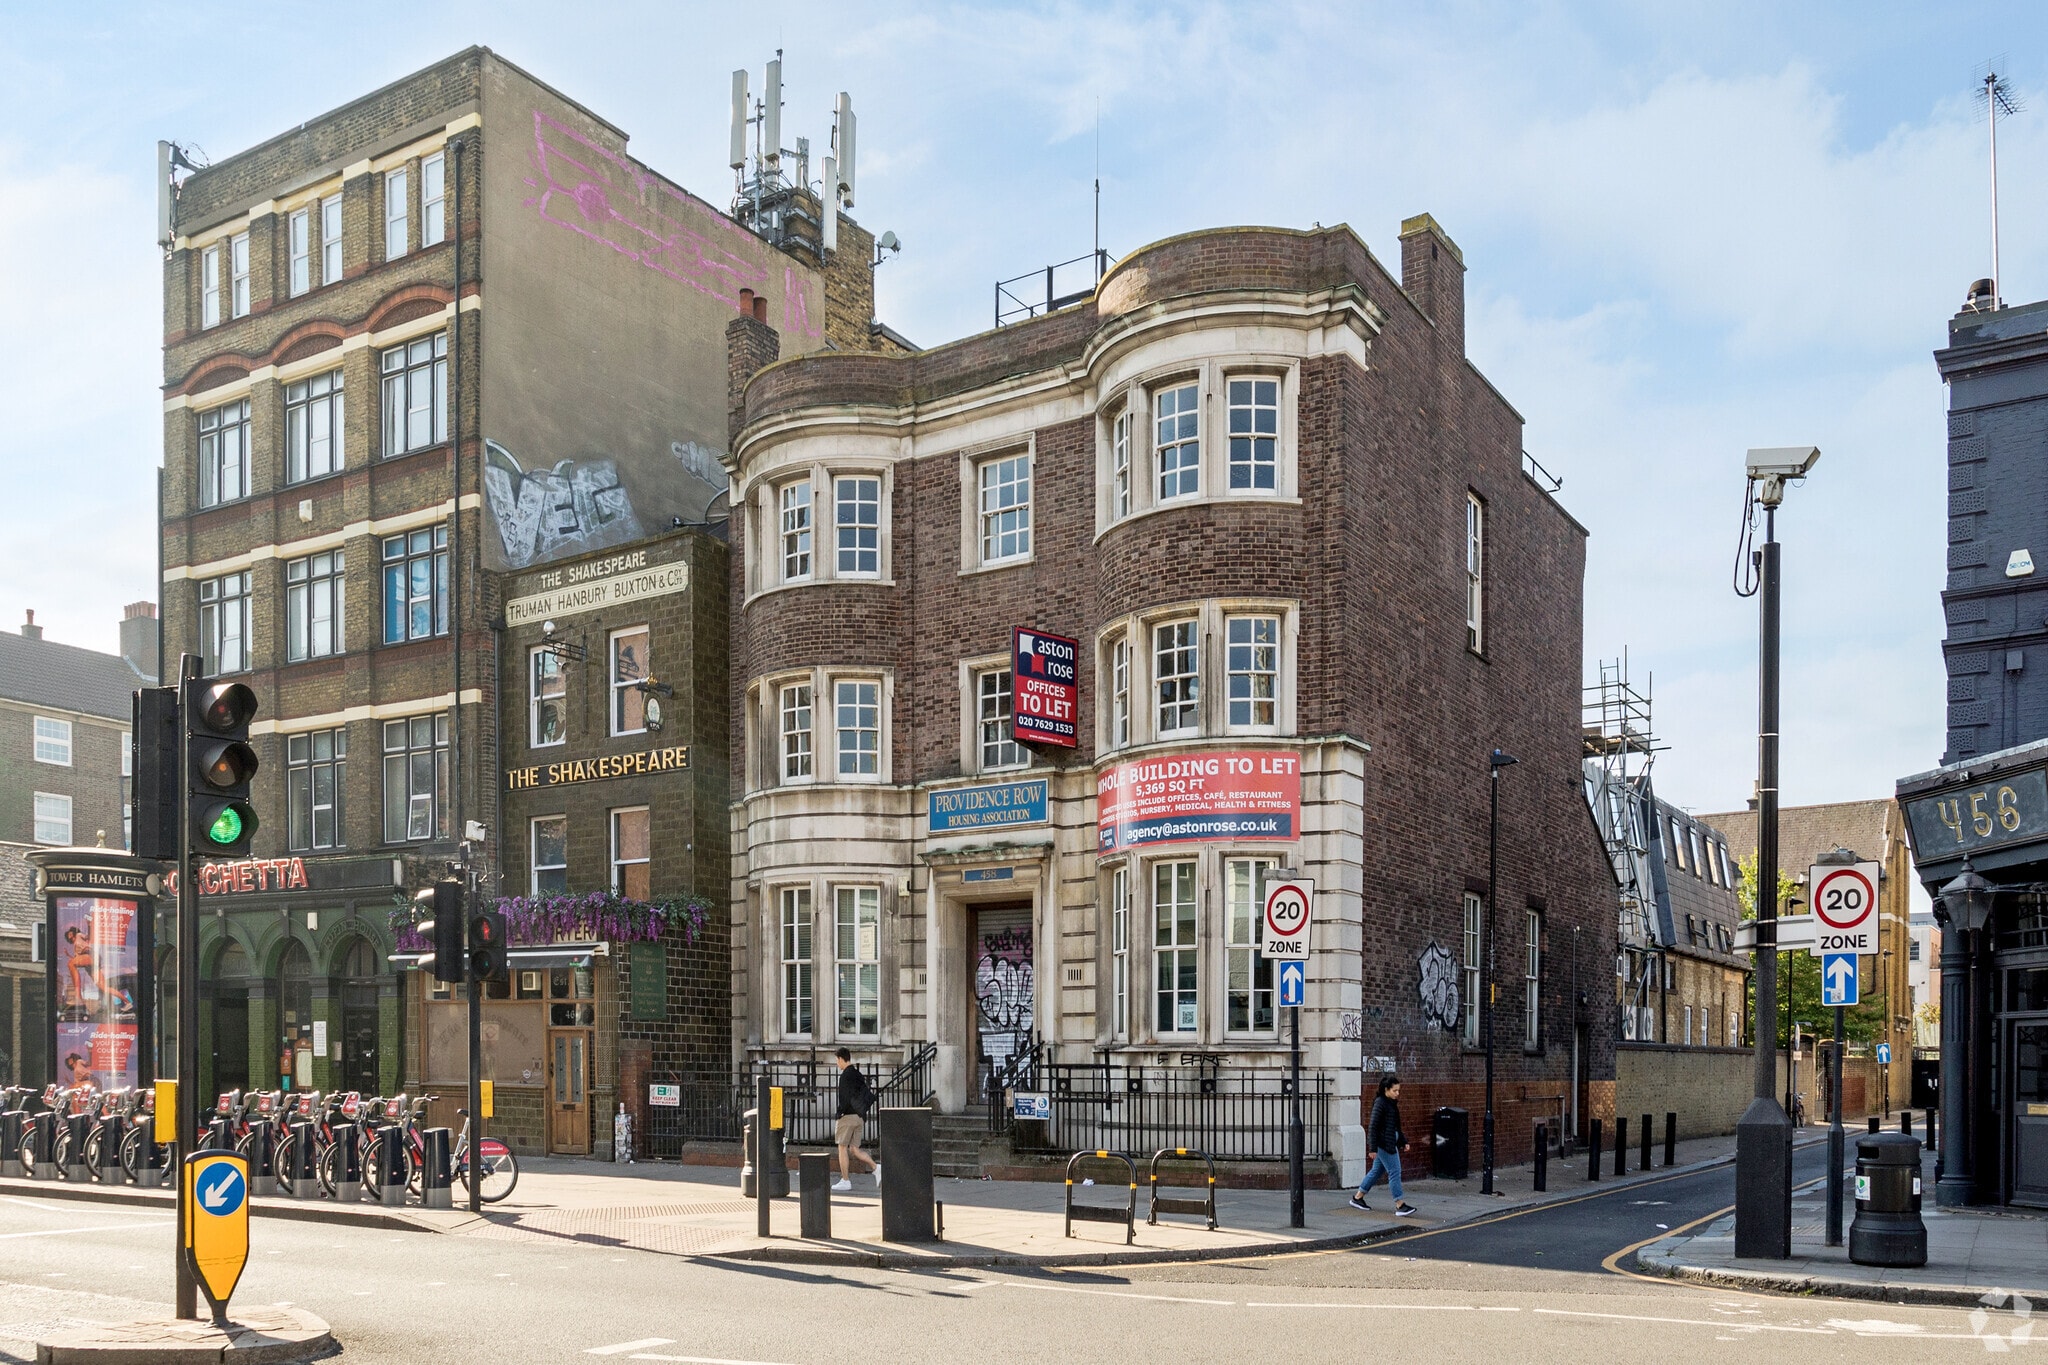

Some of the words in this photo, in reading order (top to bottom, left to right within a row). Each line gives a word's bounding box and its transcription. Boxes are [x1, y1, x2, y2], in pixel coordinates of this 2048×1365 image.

[541, 571, 562, 589] THE
[569, 551, 647, 584] SHAKESPEARE
[2009, 560, 2030, 570] SECOM
[509, 598, 551, 620] TRUMAN
[557, 585, 608, 611] HANBURY
[614, 574, 657, 599] BUXTON
[658, 576, 666, 588] &
[1037, 638, 1074, 660] aston
[1048, 661, 1074, 680] rose
[1027, 679, 1066, 698] OFFICES
[1020, 692, 1042, 713] TO
[1045, 697, 1072, 719] LET
[1018, 715, 1033, 728] 020
[1034, 718, 1054, 731] 7629
[1055, 722, 1074, 735] 1533
[508, 768, 539, 790] THE
[549, 747, 688, 785] SHAKESPEARE
[1097, 769, 1126, 796] WHOLE
[1129, 759, 1219, 784] BUILDING
[1225, 757, 1254, 775] TO
[1260, 757, 1296, 775] LET
[1136, 780, 1165, 798] 5,369
[1168, 779, 1186, 793] SQ
[1189, 778, 1205, 790] FT
[935, 789, 1010, 813] PROVIDENCE
[1013, 785, 1043, 805] ROW
[1124, 800, 1137, 809] USES
[1137, 796, 1166, 807] INCLUDE
[1168, 793, 1202, 804] OFFICES,
[1203, 790, 1227, 800] CAFÉ,
[1229, 791, 1283, 799] RESTAURANT
[1140, 804, 1173, 816] NURSERY,
[1174, 802, 1212, 812] MEDICAL,
[1214, 801, 1247, 809] HEALTH
[1257, 801, 1292, 809] FITNESS
[948, 812, 980, 827] HOUSING
[981, 808, 1030, 824] ASSOCIATION
[1938, 785, 2021, 843] 456
[1126, 818, 1278, 841] agency@astonrose.co.uk
[50, 872, 83, 883] TOWER
[89, 873, 144, 888] HAMLETS
[980, 869, 997, 880] 458
[1826, 889, 1862, 911] 20
[89, 906, 135, 917] Ride-hailing
[1275, 901, 1300, 920] 20
[1268, 941, 1302, 954] ZONE
[1820, 934, 1868, 950] ZONE
[90, 1032, 135, 1041] Ride-hailing
